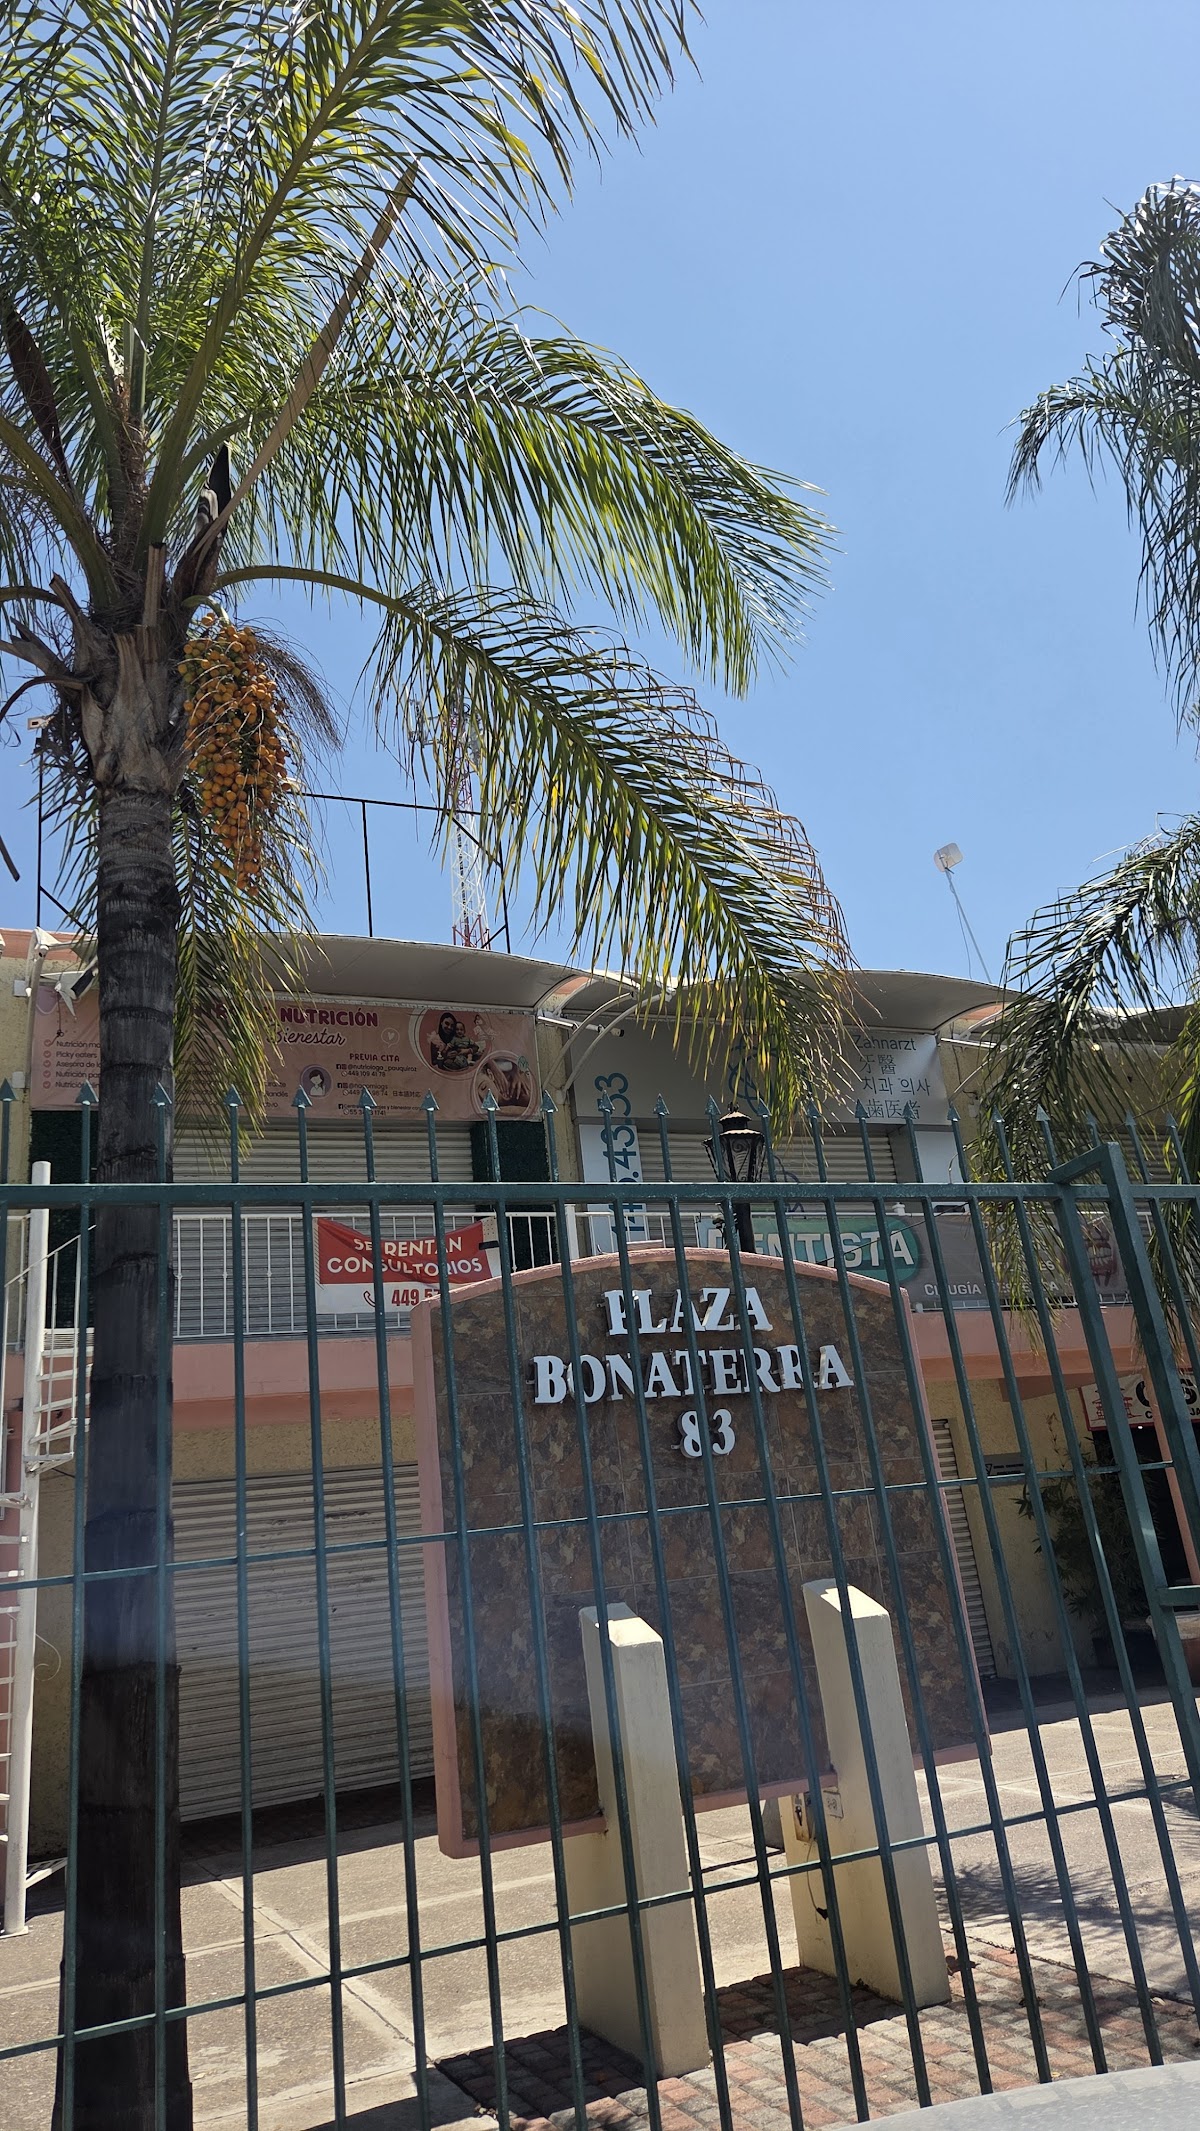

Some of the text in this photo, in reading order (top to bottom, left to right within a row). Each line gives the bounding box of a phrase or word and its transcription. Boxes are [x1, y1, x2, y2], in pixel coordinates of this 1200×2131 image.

[280, 1007, 378, 1027] NUTRICIÓN
[266, 1022, 346, 1046] Bienestar
[852, 1035, 917, 1051] Zahnarzt
[56, 1040, 88, 1048] Nutrición
[349, 1053, 400, 1062] PREVIA CITA
[862, 1076, 931, 1096] 치과 의사
[353, 1238, 373, 1251] SE
[391, 1289, 419, 1307] 449
[924, 1281, 982, 1296] CIUGÍA
[604, 1286, 773, 1336] PLAZA
[532, 1344, 854, 1404] BONATERRA
[680, 1408, 736, 1458] 83
